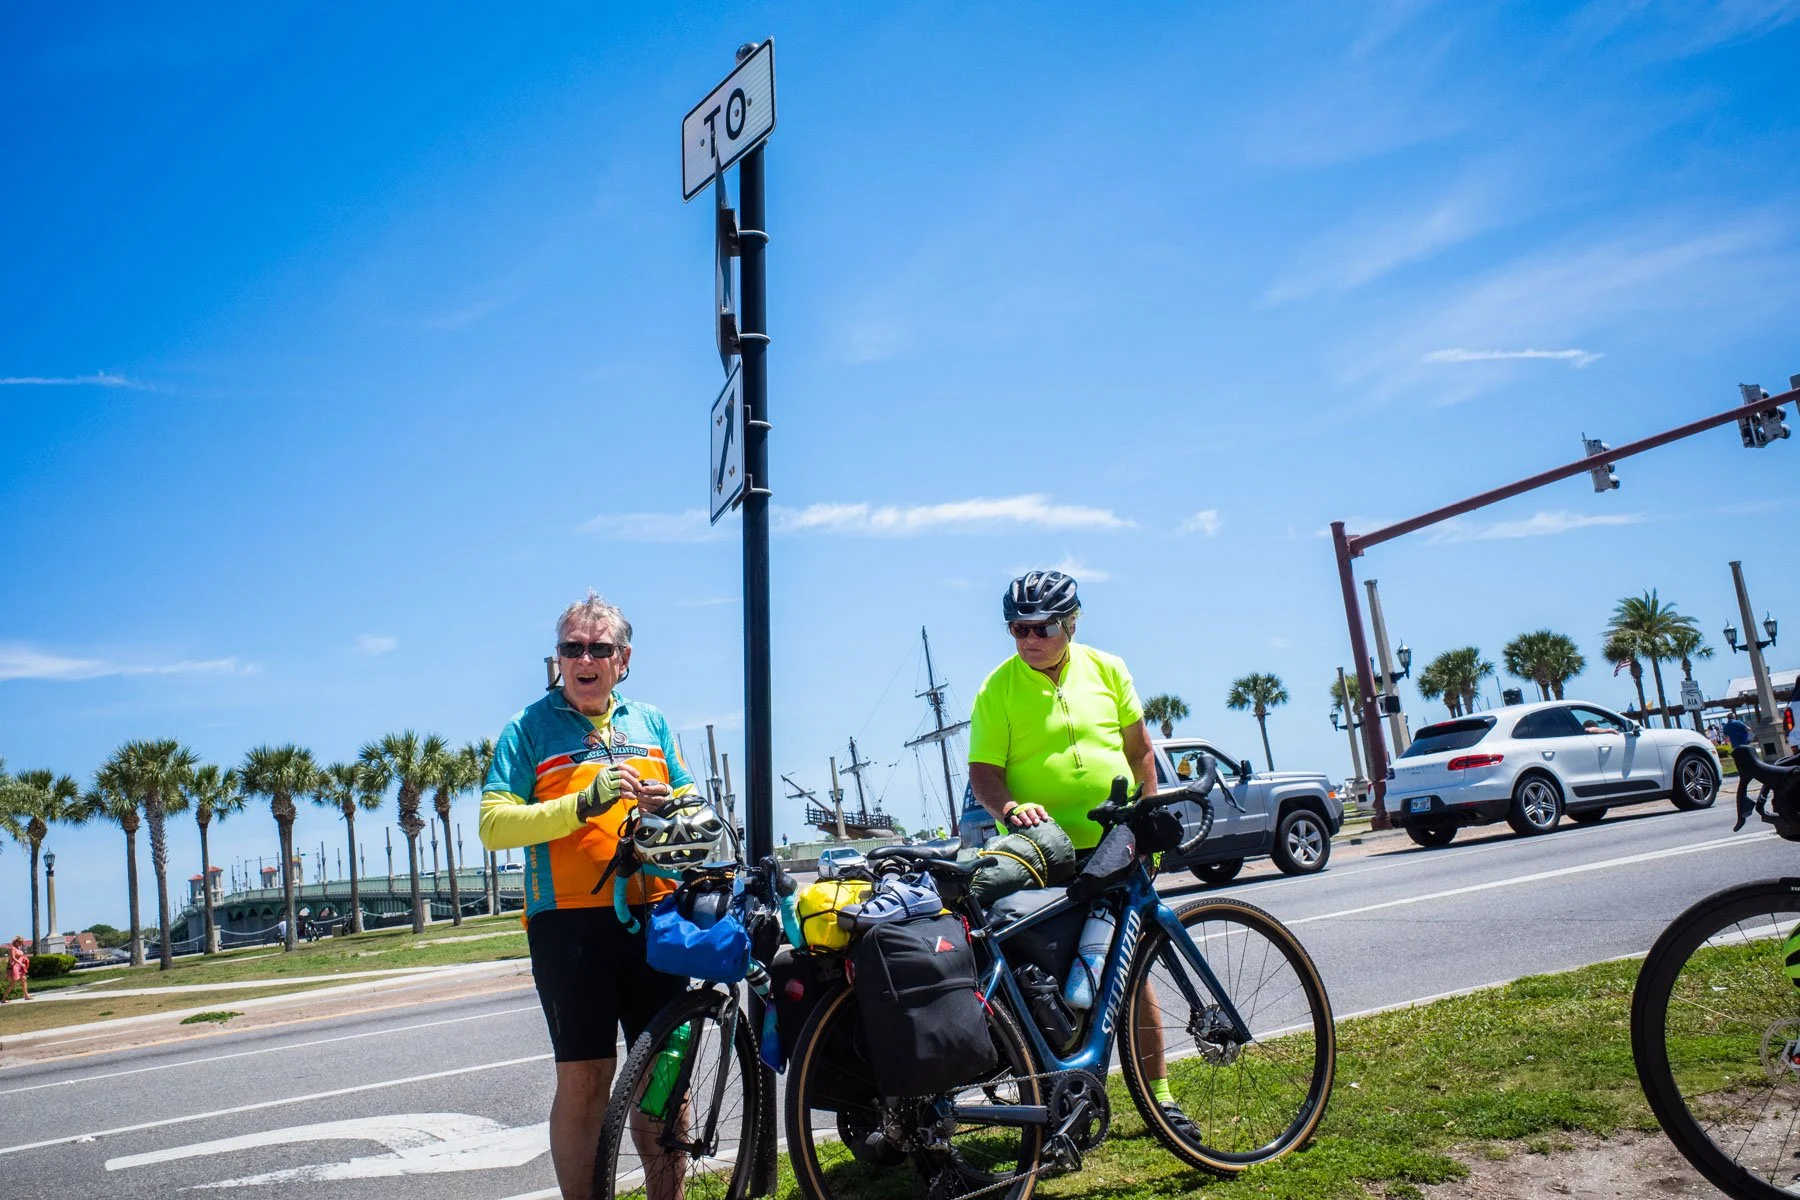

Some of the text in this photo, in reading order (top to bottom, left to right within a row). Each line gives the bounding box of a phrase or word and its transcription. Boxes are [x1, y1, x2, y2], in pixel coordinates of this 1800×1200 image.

[703, 87, 746, 159] TO
[1687, 698, 1699, 706] A1A
[1102, 909, 1140, 1040] SPECIALIZED
